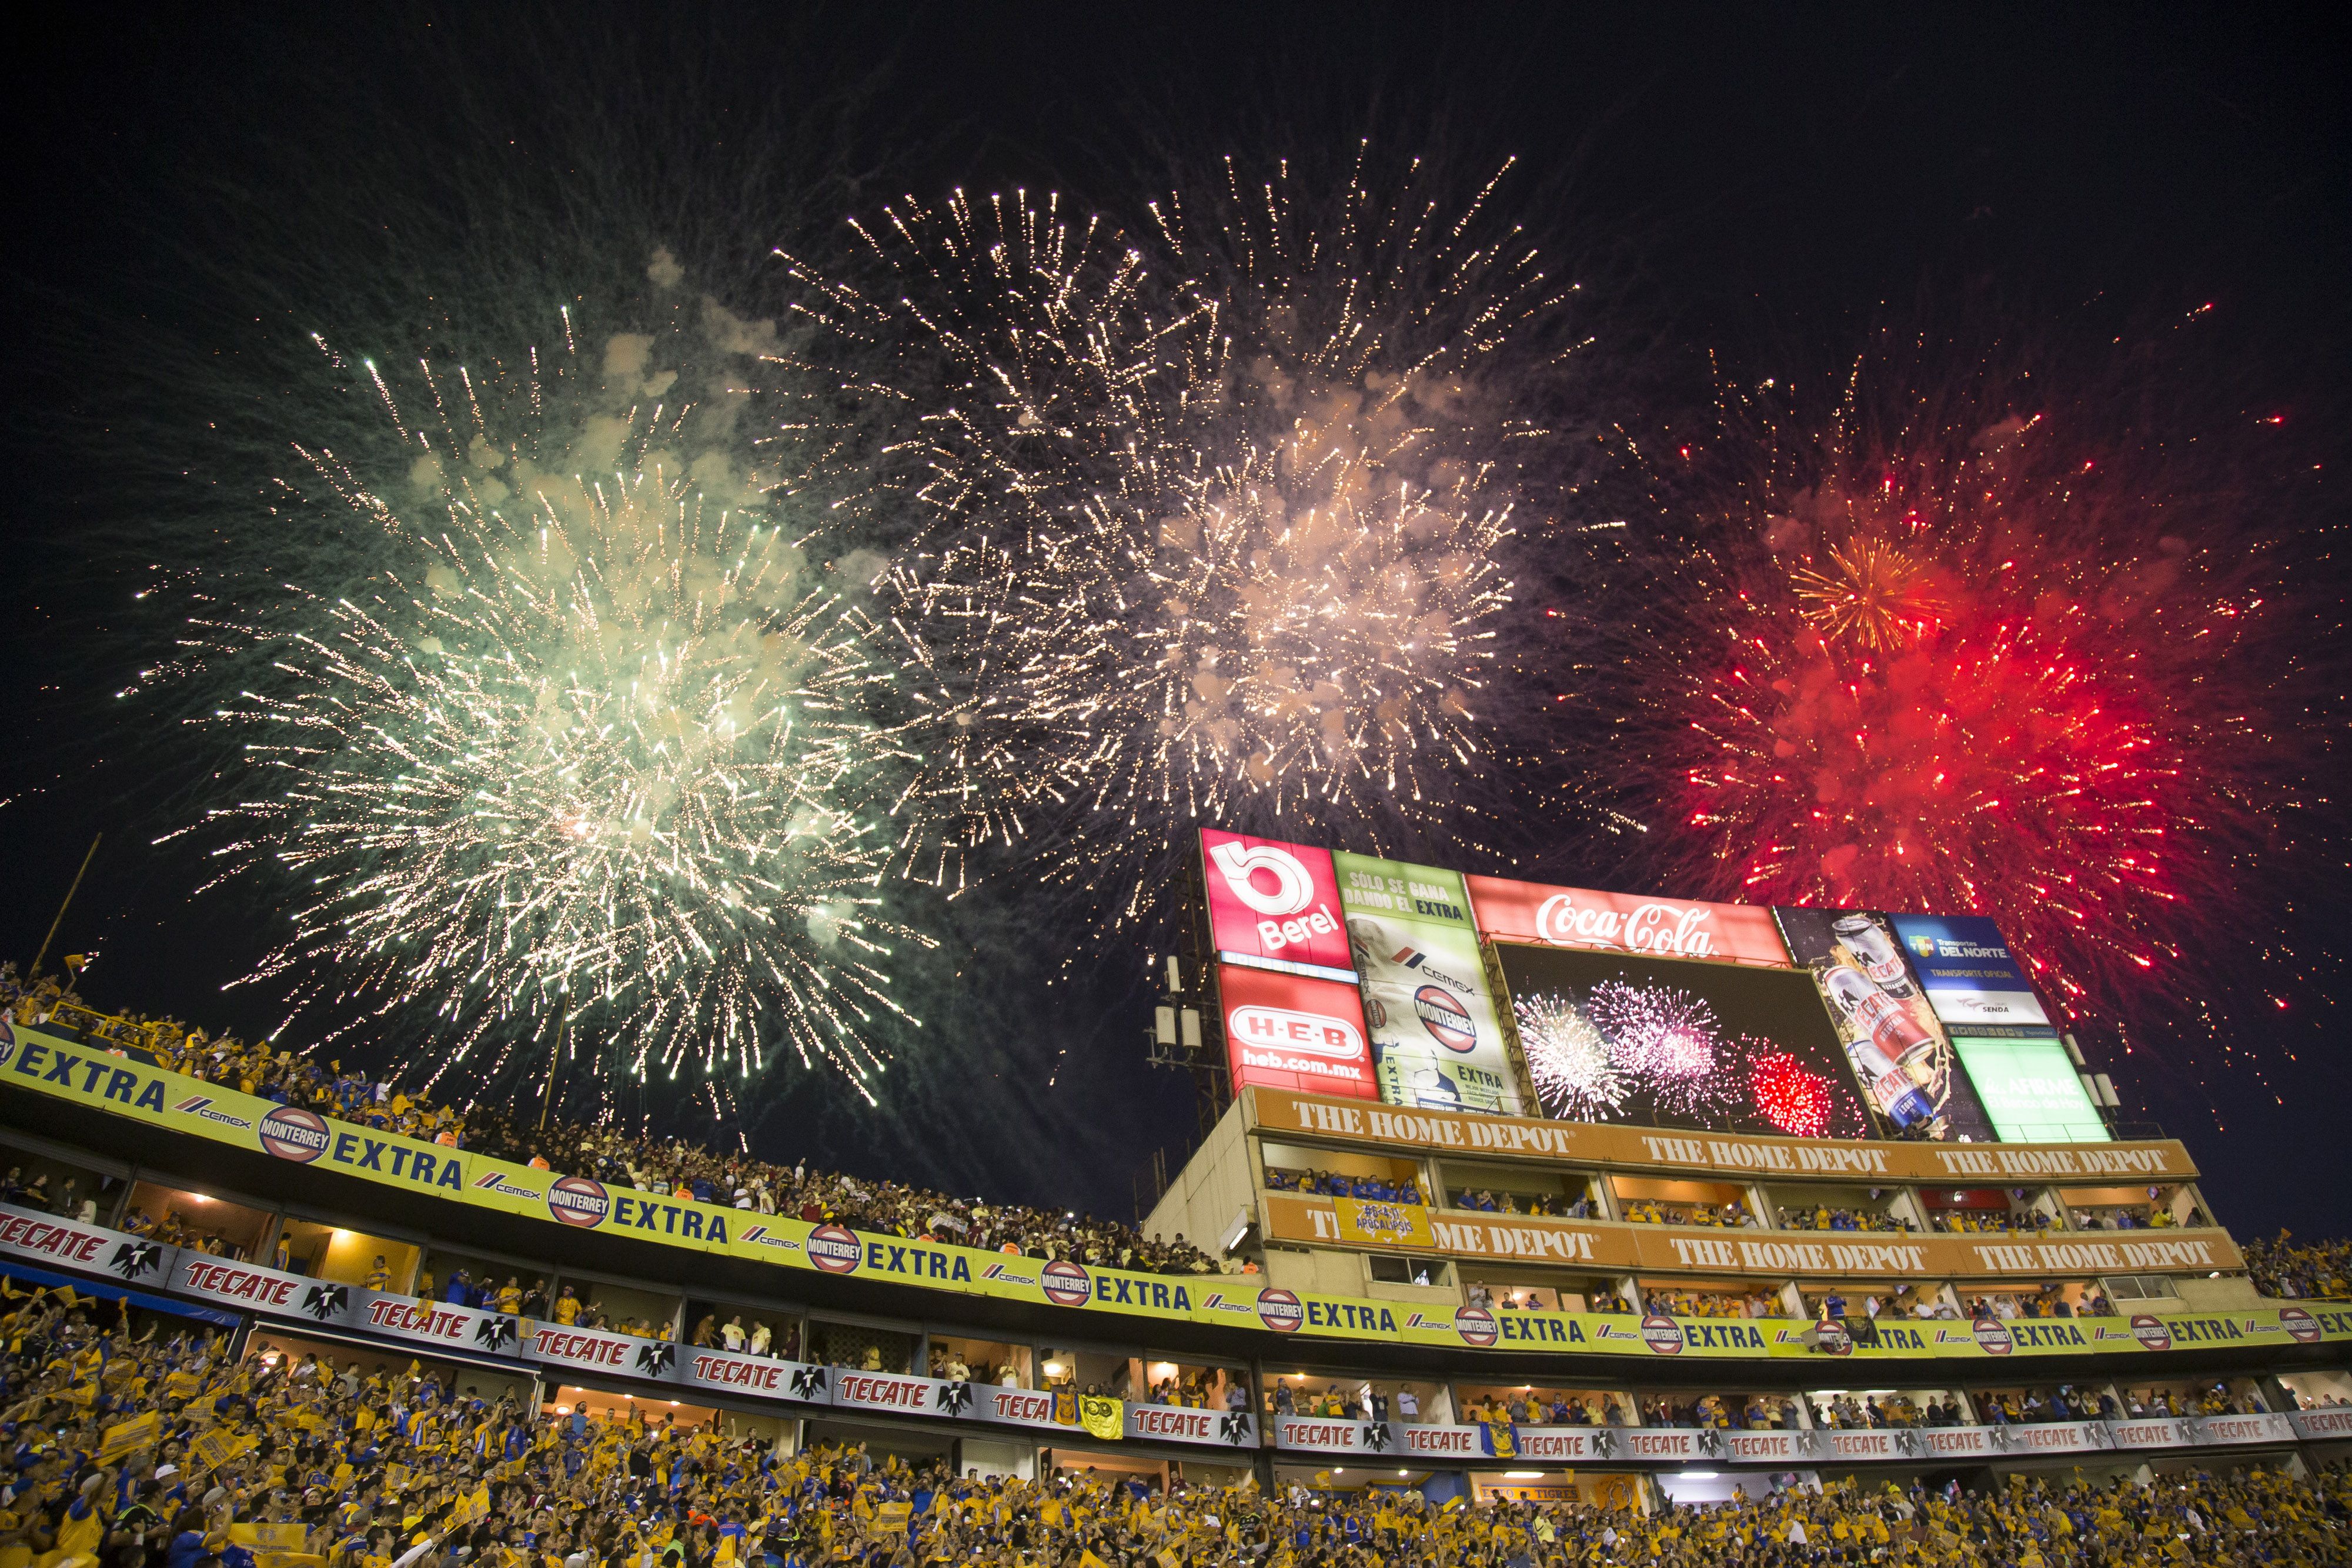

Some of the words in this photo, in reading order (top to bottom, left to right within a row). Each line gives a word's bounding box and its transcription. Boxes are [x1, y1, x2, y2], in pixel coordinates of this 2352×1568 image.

[1349, 871, 1384, 891] SÓLO
[1388, 878, 1406, 894] SE
[1409, 881, 1450, 901] GANA
[1344, 888, 1393, 910] DANDO
[1396, 896, 1413, 912] EL
[1416, 900, 1464, 921] EXTRA
[1257, 903, 1339, 951] Berel
[1535, 894, 1713, 958] Coca-Cola
[1912, 942, 1934, 951] TDN
[1937, 938, 1977, 947] Transportes
[1939, 946, 1964, 958] DEL
[1963, 947, 2008, 958] NORTE
[1421, 965, 1475, 997] CEMEX
[1866, 955, 1903, 980] ECATE
[1930, 969, 1983, 978] TRANSPORTE
[1984, 970, 2014, 979] OFICIAL
[1248, 1017, 1347, 1047] H-E-B
[1415, 999, 1476, 1037] MONTERREY
[1242, 1049, 1362, 1079] heb.com.mx
[1457, 1065, 1504, 1090] EXTRA
[14, 1042, 166, 1114] EXTRA
[199, 1108, 252, 1130] CEMEX
[1385, 1056, 1403, 1106] EXTRA
[1875, 1066, 1913, 1105] ECATE
[2008, 1078, 2080, 1096] AFIRME
[1898, 1096, 1917, 1114] LIGHT
[2000, 1097, 2040, 1109] Banco
[2060, 1098, 2086, 1111] Hoy
[1293, 1101, 1364, 1135] THE
[1367, 1110, 1465, 1147] HOME
[1466, 1121, 1570, 1154] DEPOT
[260, 1118, 330, 1149] MONTERREY
[332, 1132, 463, 1192] EXTRA
[1642, 1136, 1708, 1164] THE
[1708, 1141, 1796, 1170] HOME
[1795, 1146, 1889, 1172] DEPOT
[1936, 1150, 2000, 1174] THE
[1996, 1151, 2084, 1174] HOME
[2077, 1149, 2168, 1172] DEPOT
[495, 1183, 542, 1201] CEMEX
[548, 1189, 609, 1215] MONTERREY
[613, 1196, 728, 1245] EXTRA
[1356, 1217, 1414, 1232] APOCALIPSIS
[0, 1212, 109, 1262] TECATE
[1485, 1226, 1595, 1259] DEPOT
[759, 1236, 801, 1251] CEMEX
[807, 1238, 861, 1261] MONTERREY
[867, 1242, 973, 1283] EXTRA
[1670, 1238, 1739, 1267] THE
[1738, 1241, 1830, 1270] HOME
[1828, 1244, 1926, 1271] DEPOT
[1973, 1245, 2040, 1270] THE
[2036, 1243, 2126, 1269] HOME
[2119, 1240, 2216, 1266] DEPOT
[183, 1261, 300, 1306] TECATE
[998, 1273, 1036, 1285] CEMEX
[1042, 1274, 1091, 1293] MONTERREY
[1096, 1275, 1192, 1312] EXTRA
[366, 1299, 472, 1339] TECATE
[1218, 1302, 1253, 1313] CEMEX
[1257, 1300, 1302, 1319] MONTERREY
[1307, 1300, 1398, 1333] EXTRA
[1419, 1321, 1452, 1330] CEMEX
[1455, 1318, 1497, 1333] MONTERREY
[1499, 1316, 1586, 1343] EXTRA
[2168, 1318, 2244, 1342] EXTRA
[533, 1328, 632, 1366] TECATE
[1642, 1327, 1682, 1342] MONTERREY
[1684, 1324, 1766, 1348] EXTRA
[2011, 1325, 2087, 1346] EXTRA
[692, 1355, 785, 1390] TECATE
[838, 1375, 931, 1407] TECATE
[991, 1393, 1051, 1422] TECA
[1131, 1409, 1212, 1438] TECATE
[1281, 1423, 1355, 1447] TECATE
[2022, 1428, 2080, 1447] TECATE
[2117, 1424, 2172, 1445] TECATE
[2208, 1419, 2264, 1440] TECATE
[1404, 1428, 1473, 1452] TECATE
[1520, 1435, 1585, 1456] TECATE
[1628, 1434, 1691, 1455] TECATE
[1728, 1435, 1790, 1456] TECATE
[1830, 1435, 1889, 1455] TECATE
[1926, 1431, 1984, 1452] TECATE
[1534, 1489, 1578, 1499] TIGRES
